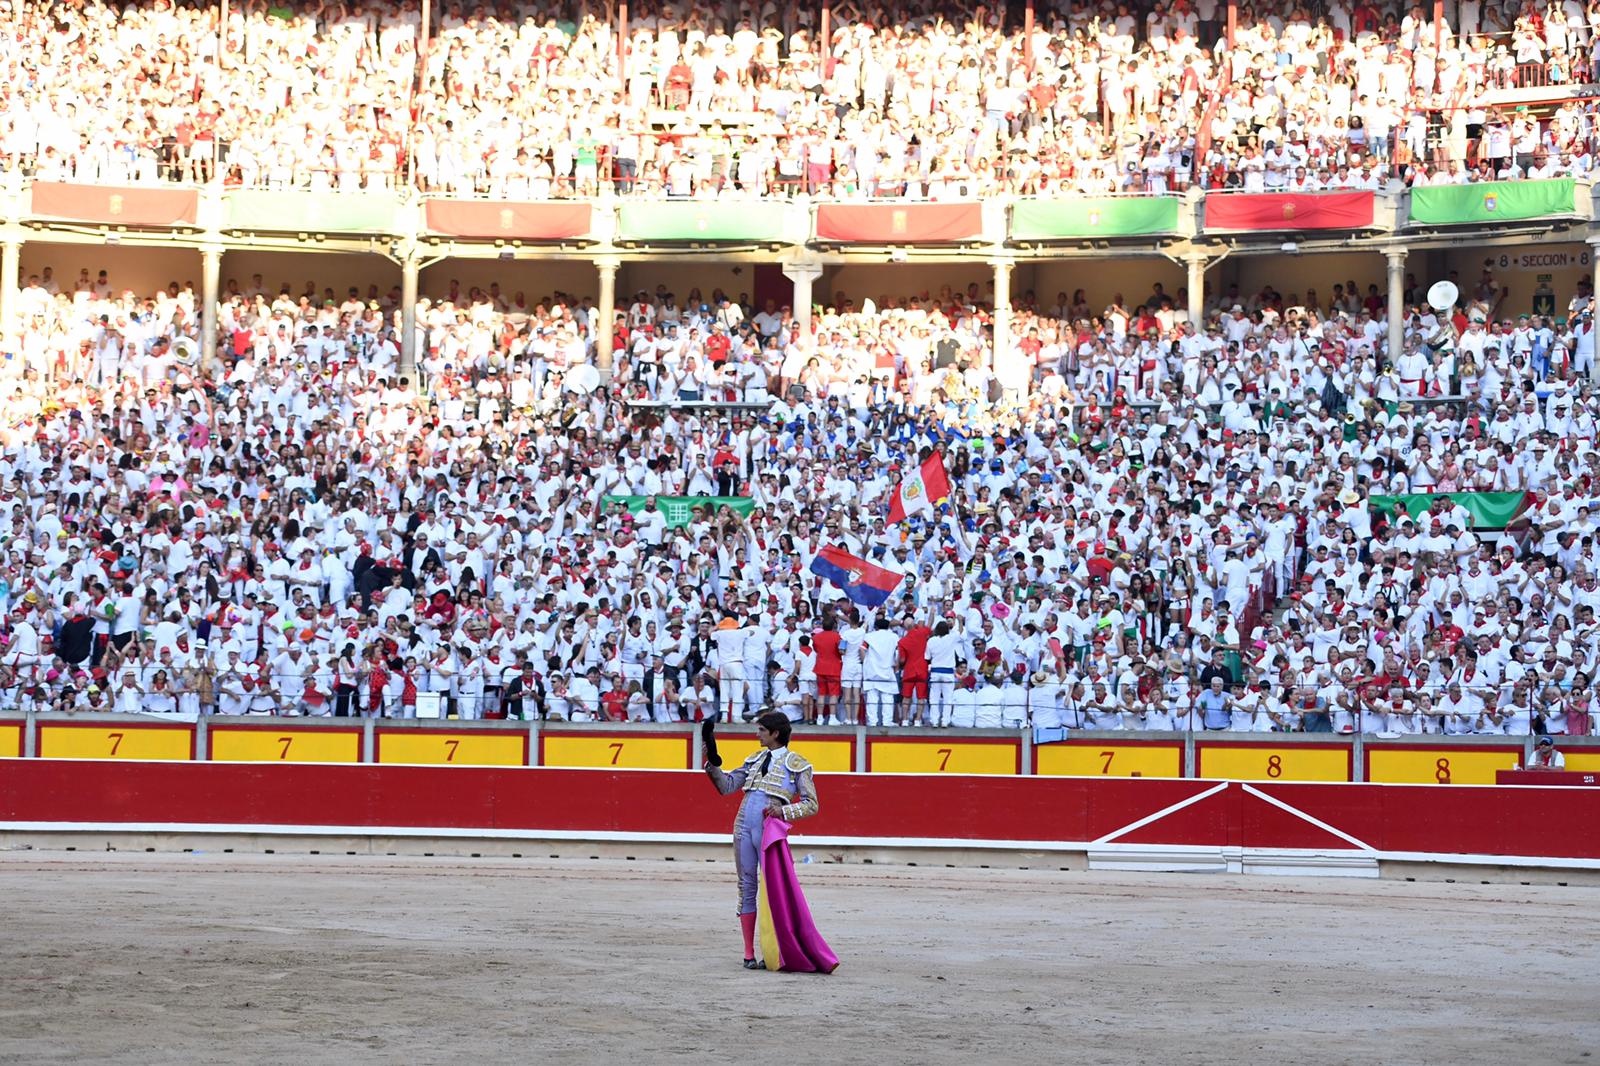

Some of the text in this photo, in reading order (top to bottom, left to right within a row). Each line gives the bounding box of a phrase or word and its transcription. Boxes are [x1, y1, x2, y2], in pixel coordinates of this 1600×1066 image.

[1499, 251, 1589, 268] 8 SECCION 8
[108, 733, 124, 755] 7
[278, 737, 293, 759] 7
[445, 740, 460, 761] 7
[609, 743, 624, 764] 7
[937, 749, 952, 771] 7
[1100, 752, 1115, 774] 7
[1266, 754, 1282, 778] 8
[1435, 757, 1452, 780] 8
